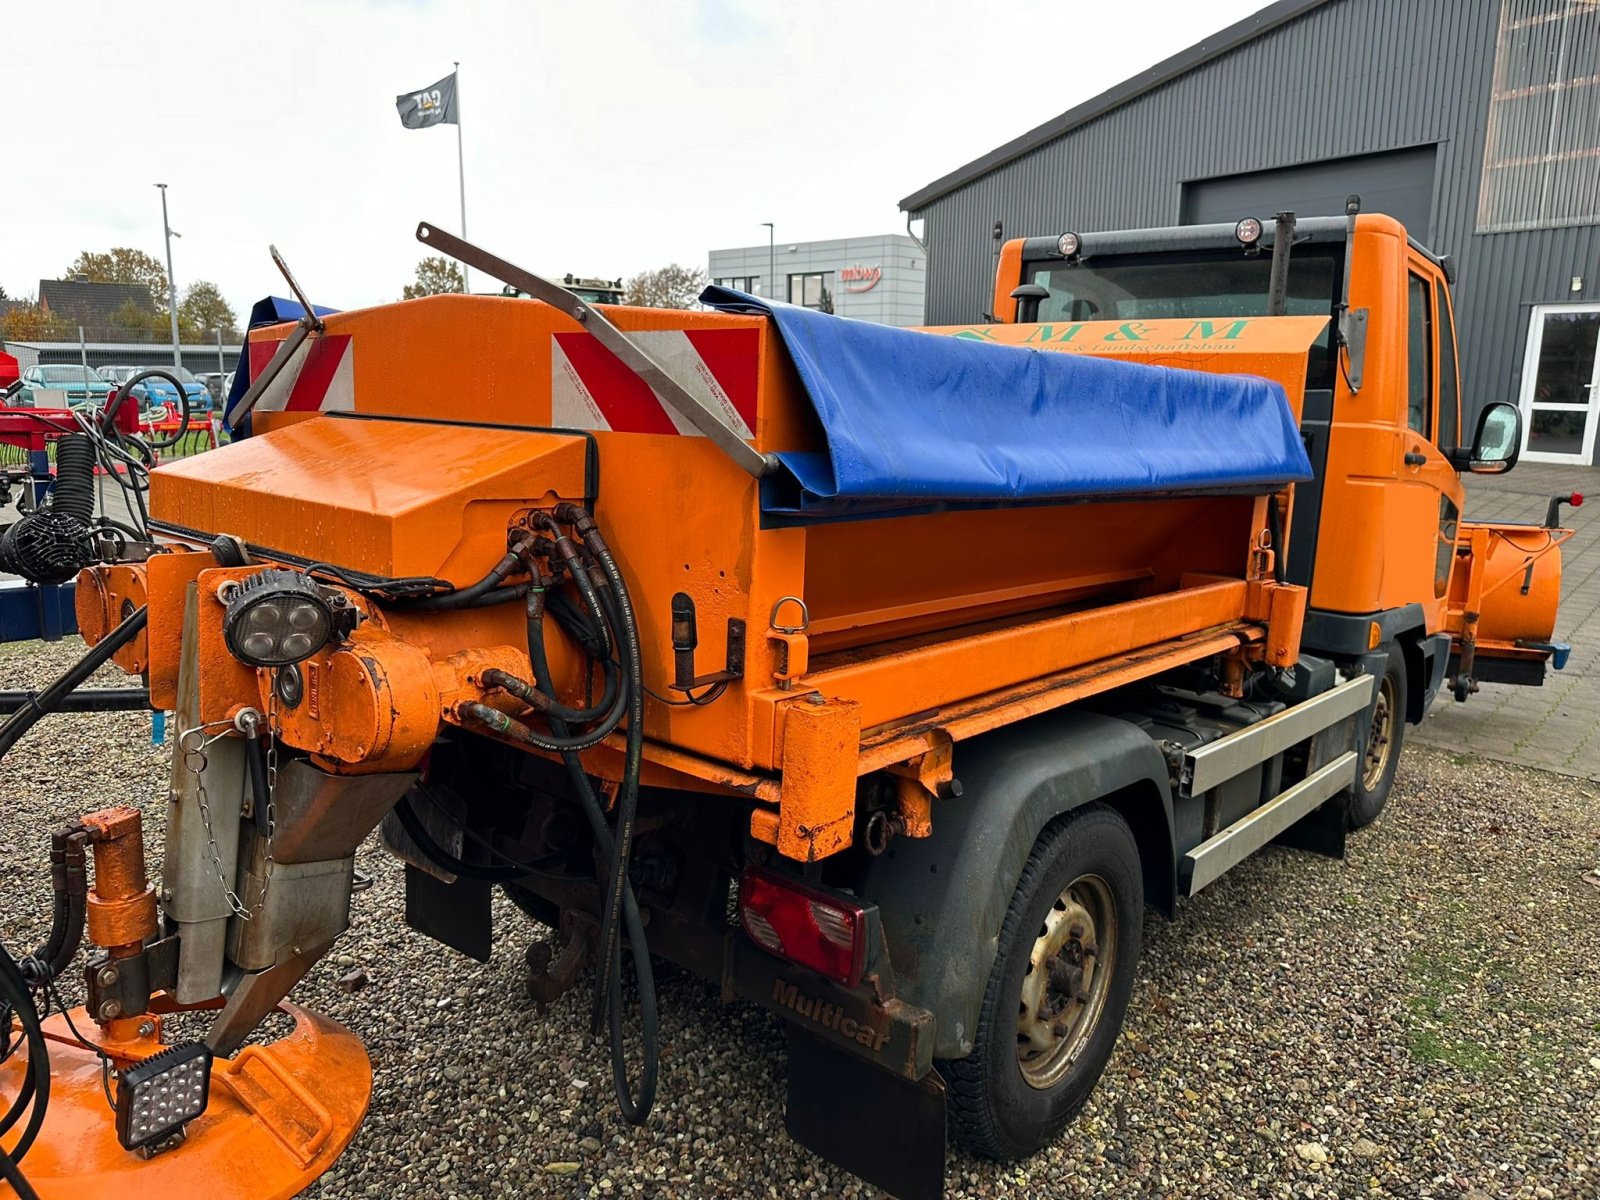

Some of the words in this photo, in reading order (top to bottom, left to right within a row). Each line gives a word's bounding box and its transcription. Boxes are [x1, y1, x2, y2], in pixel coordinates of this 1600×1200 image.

[1021, 324, 1091, 343] M
[1103, 321, 1158, 341] &
[1175, 320, 1256, 340] M
[1091, 343, 1237, 352] Landschaftsbau
[773, 979, 890, 1051] Multicar
